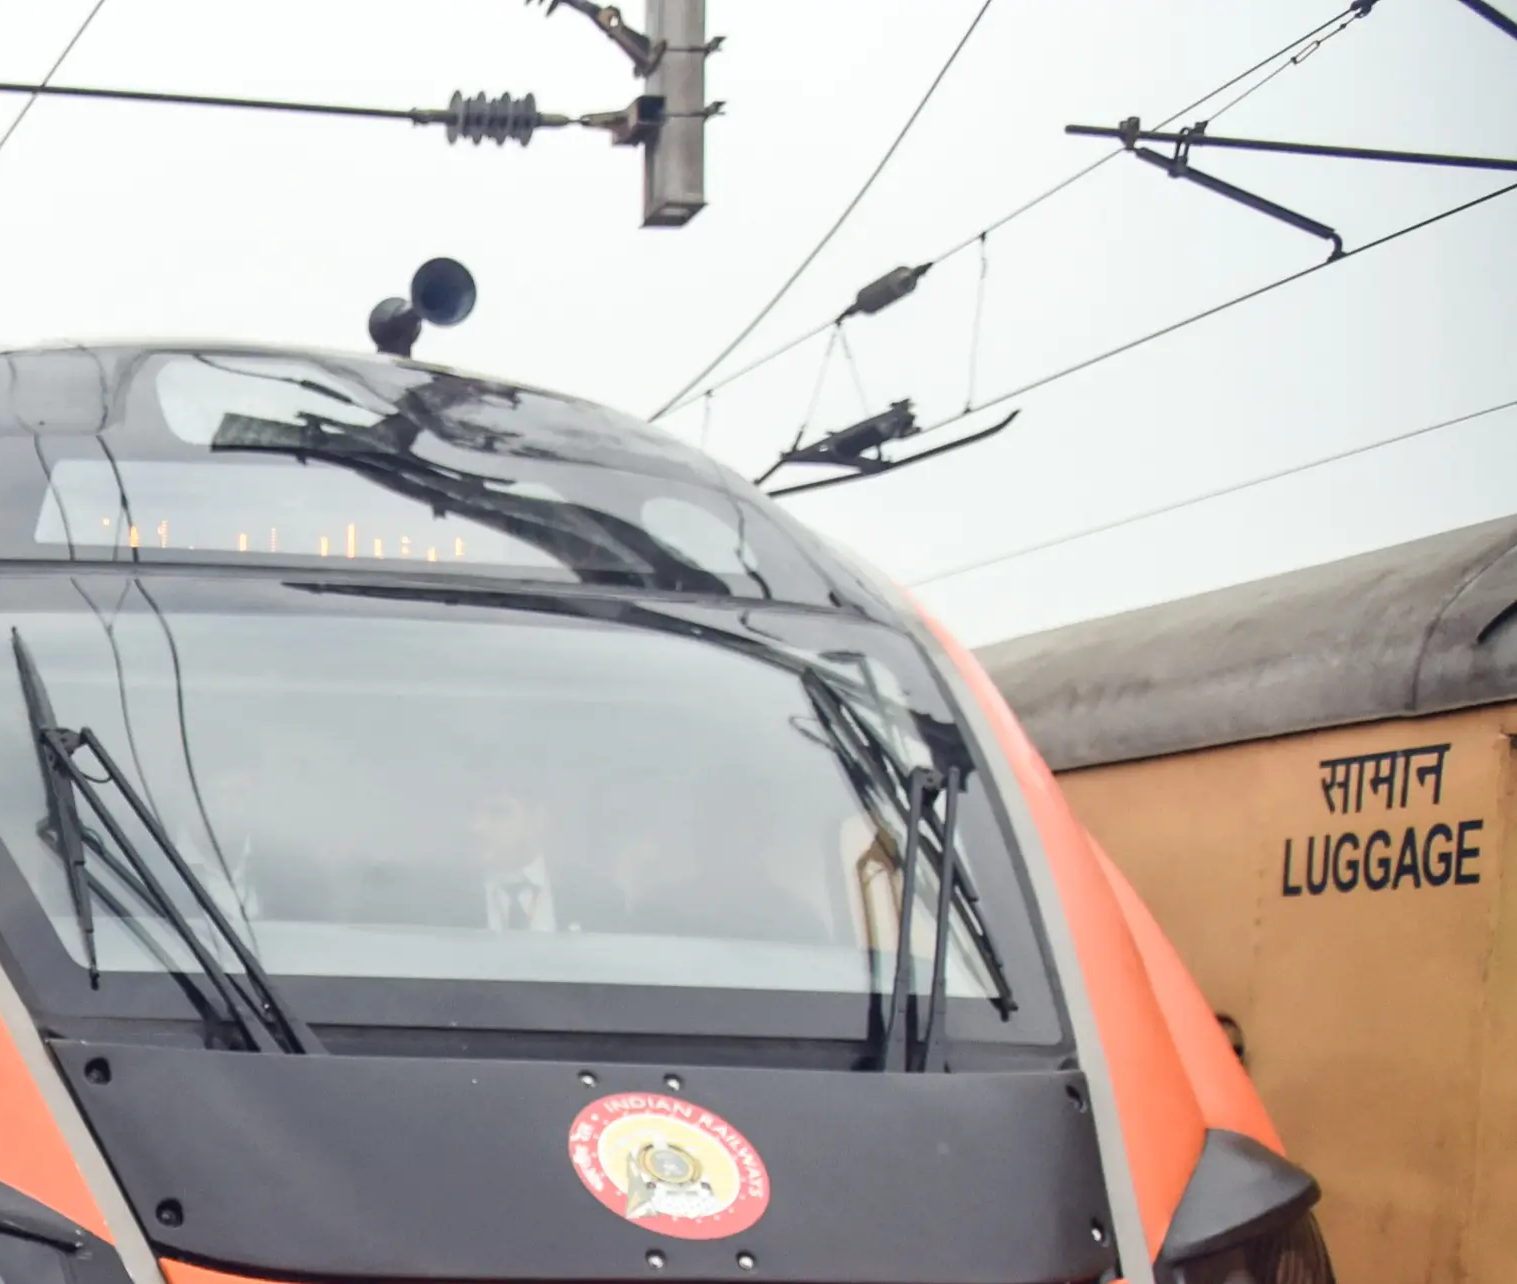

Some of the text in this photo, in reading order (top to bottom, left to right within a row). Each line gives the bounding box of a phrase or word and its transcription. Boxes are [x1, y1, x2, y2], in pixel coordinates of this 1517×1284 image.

[1319, 743, 1452, 814] सामान
[1282, 819, 1484, 897] LUGGAGE
[603, 1096, 764, 1199] INDIAN RAILWAYS
